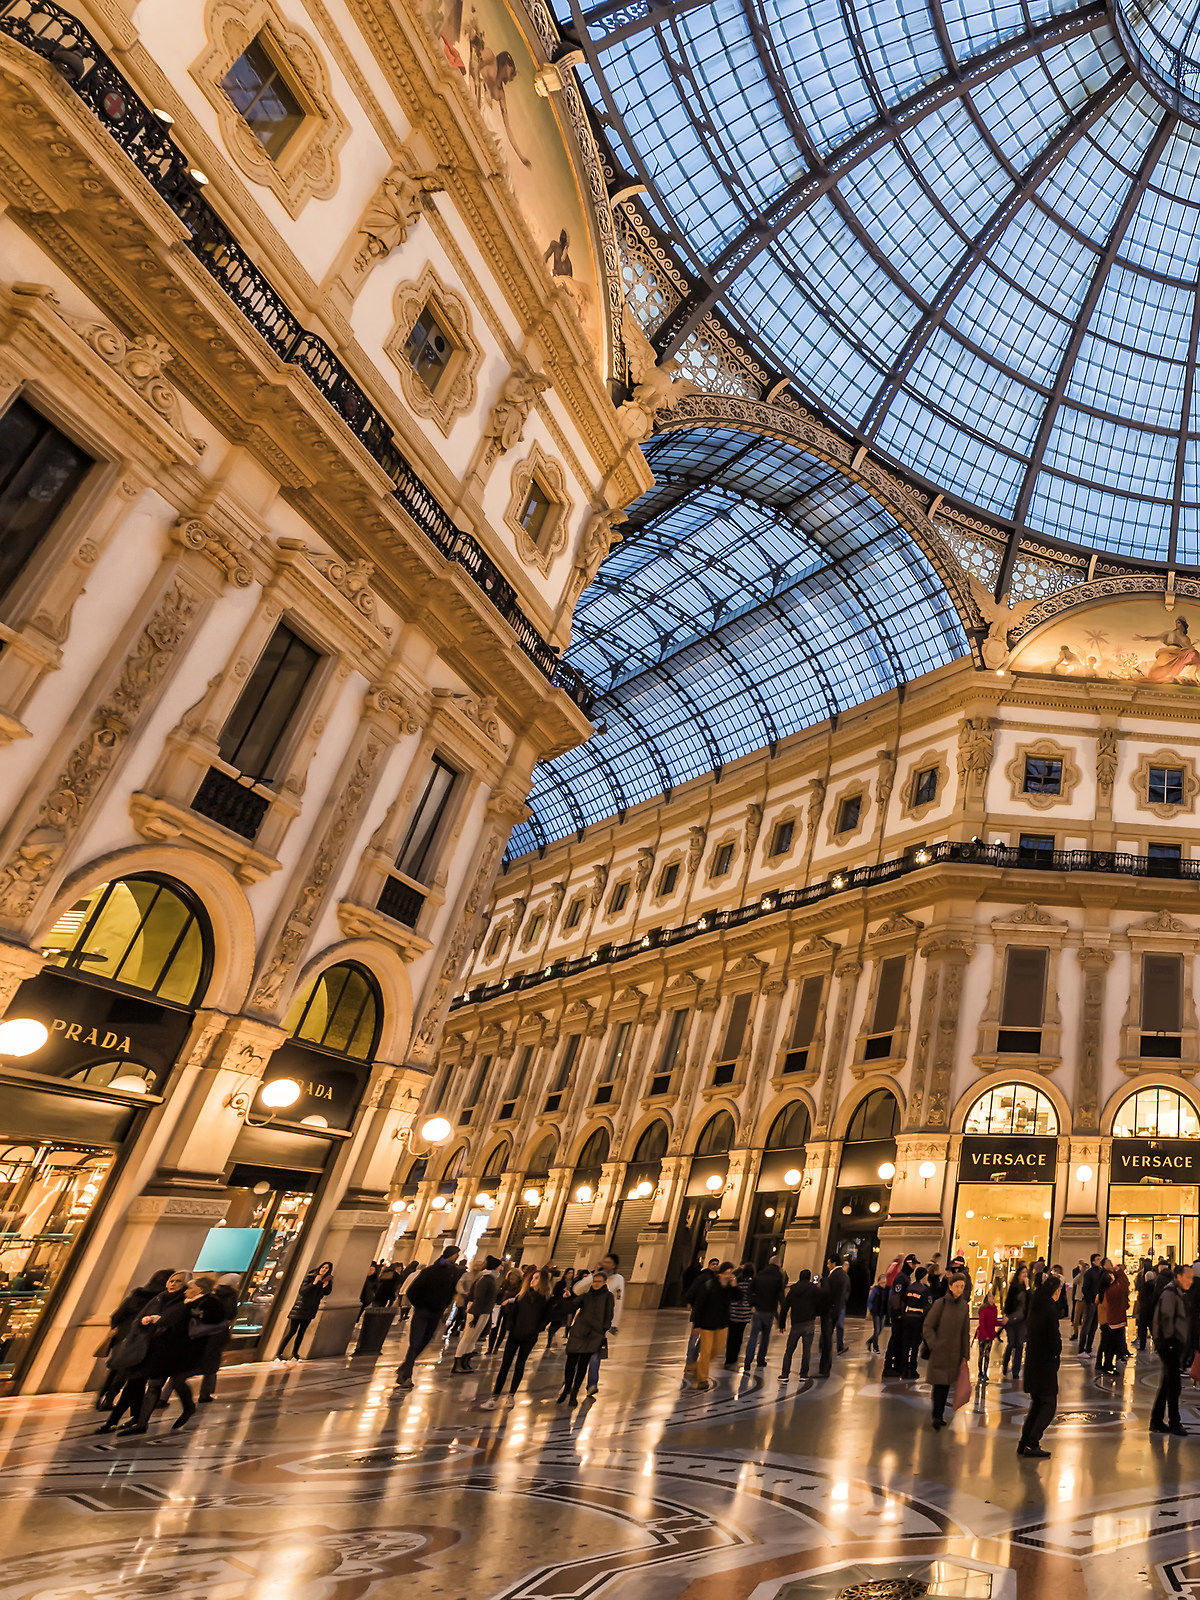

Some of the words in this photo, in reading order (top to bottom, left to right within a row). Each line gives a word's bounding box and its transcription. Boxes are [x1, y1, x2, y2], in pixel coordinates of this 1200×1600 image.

[50, 1018, 131, 1054] PRADA
[971, 1153, 1047, 1166] VERSACE
[1121, 1155, 1193, 1168] VERSACE
